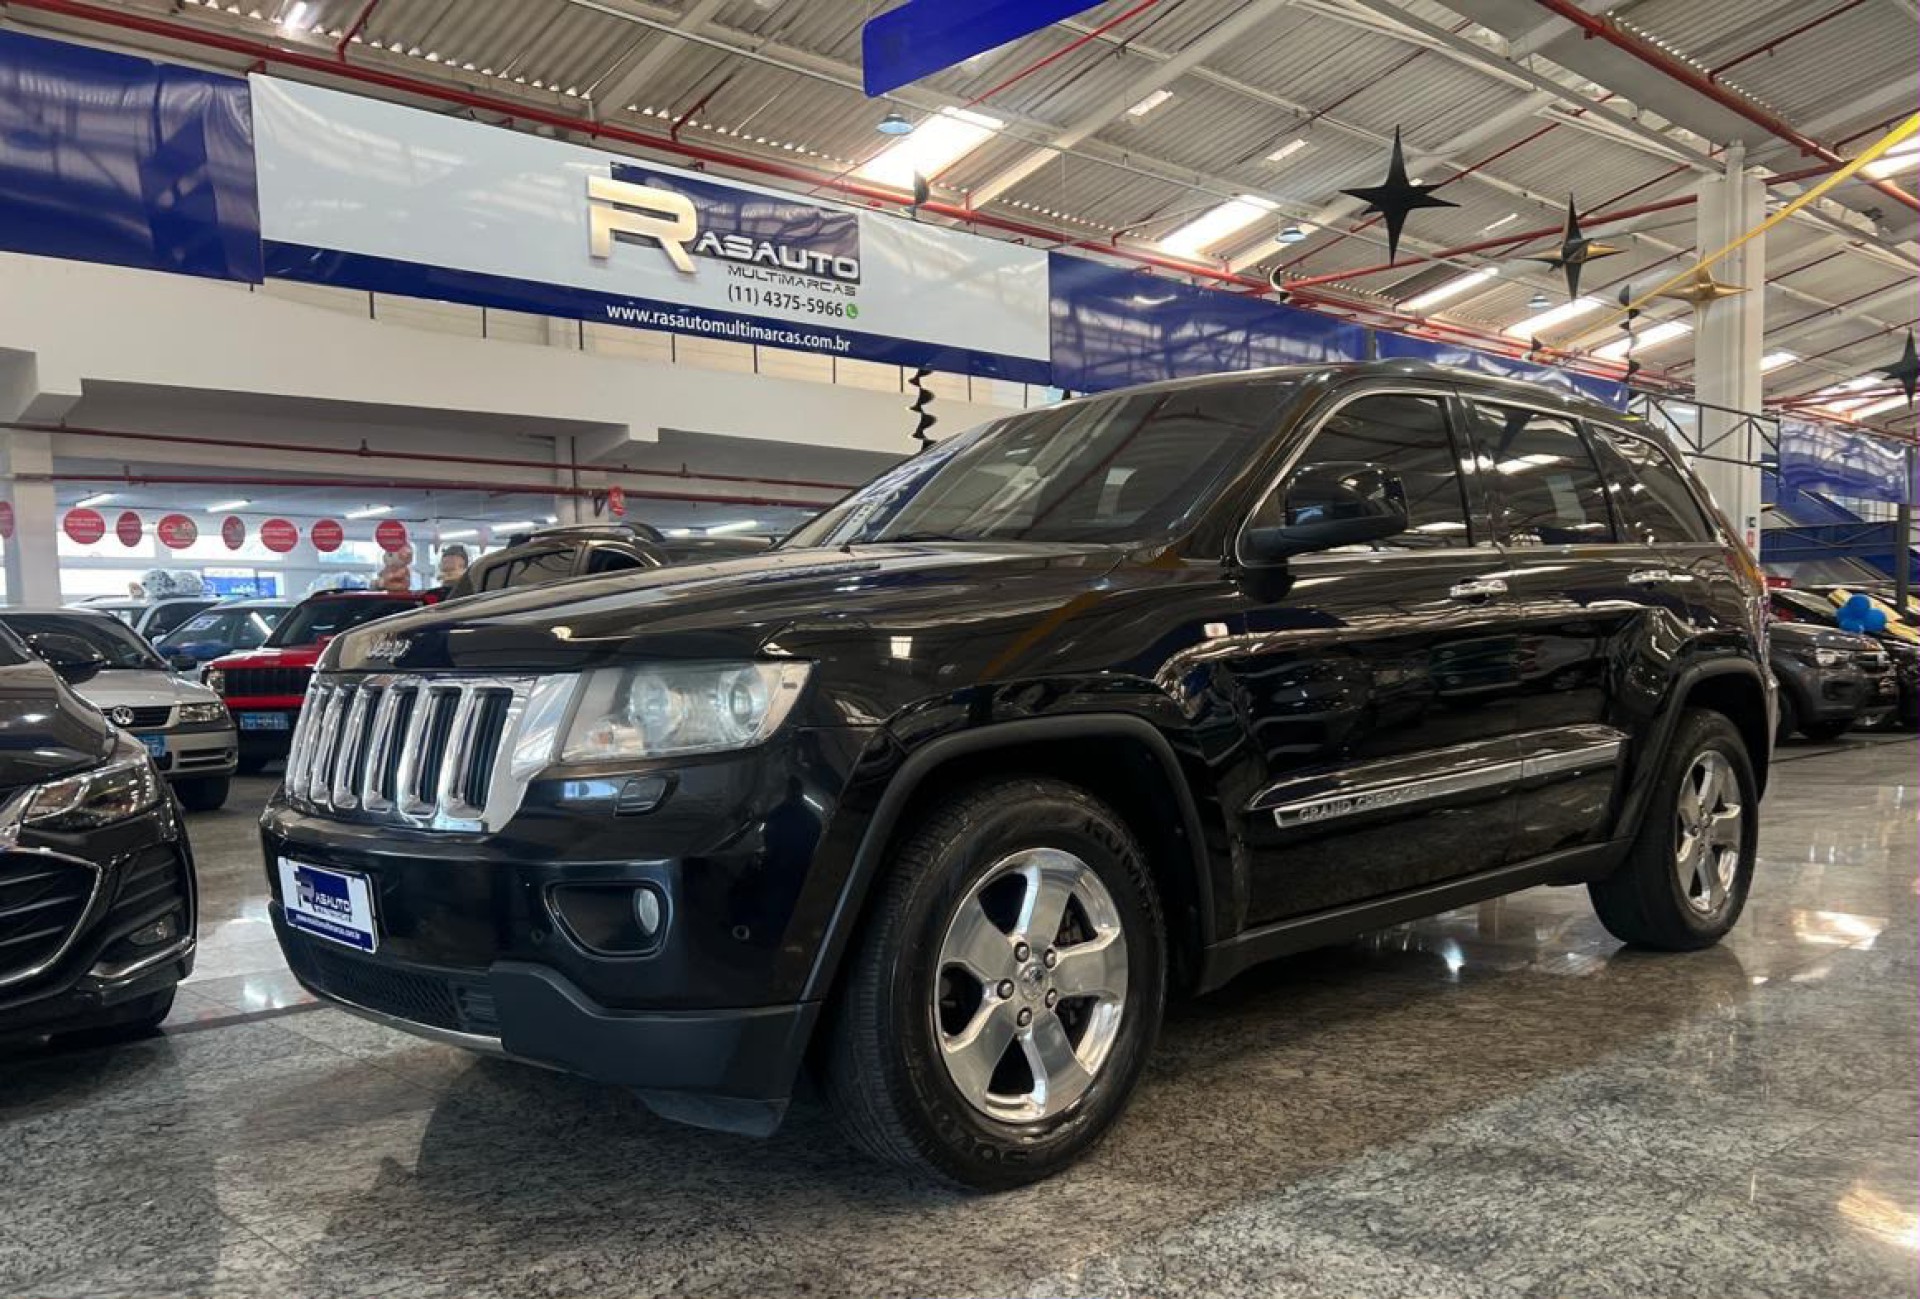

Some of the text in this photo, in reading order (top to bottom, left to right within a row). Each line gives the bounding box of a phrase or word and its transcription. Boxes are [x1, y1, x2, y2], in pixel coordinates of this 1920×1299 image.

[728, 285, 843, 318] (11) 4375-5966
[606, 302, 851, 352] www.rasautomultimarcas.com.br
